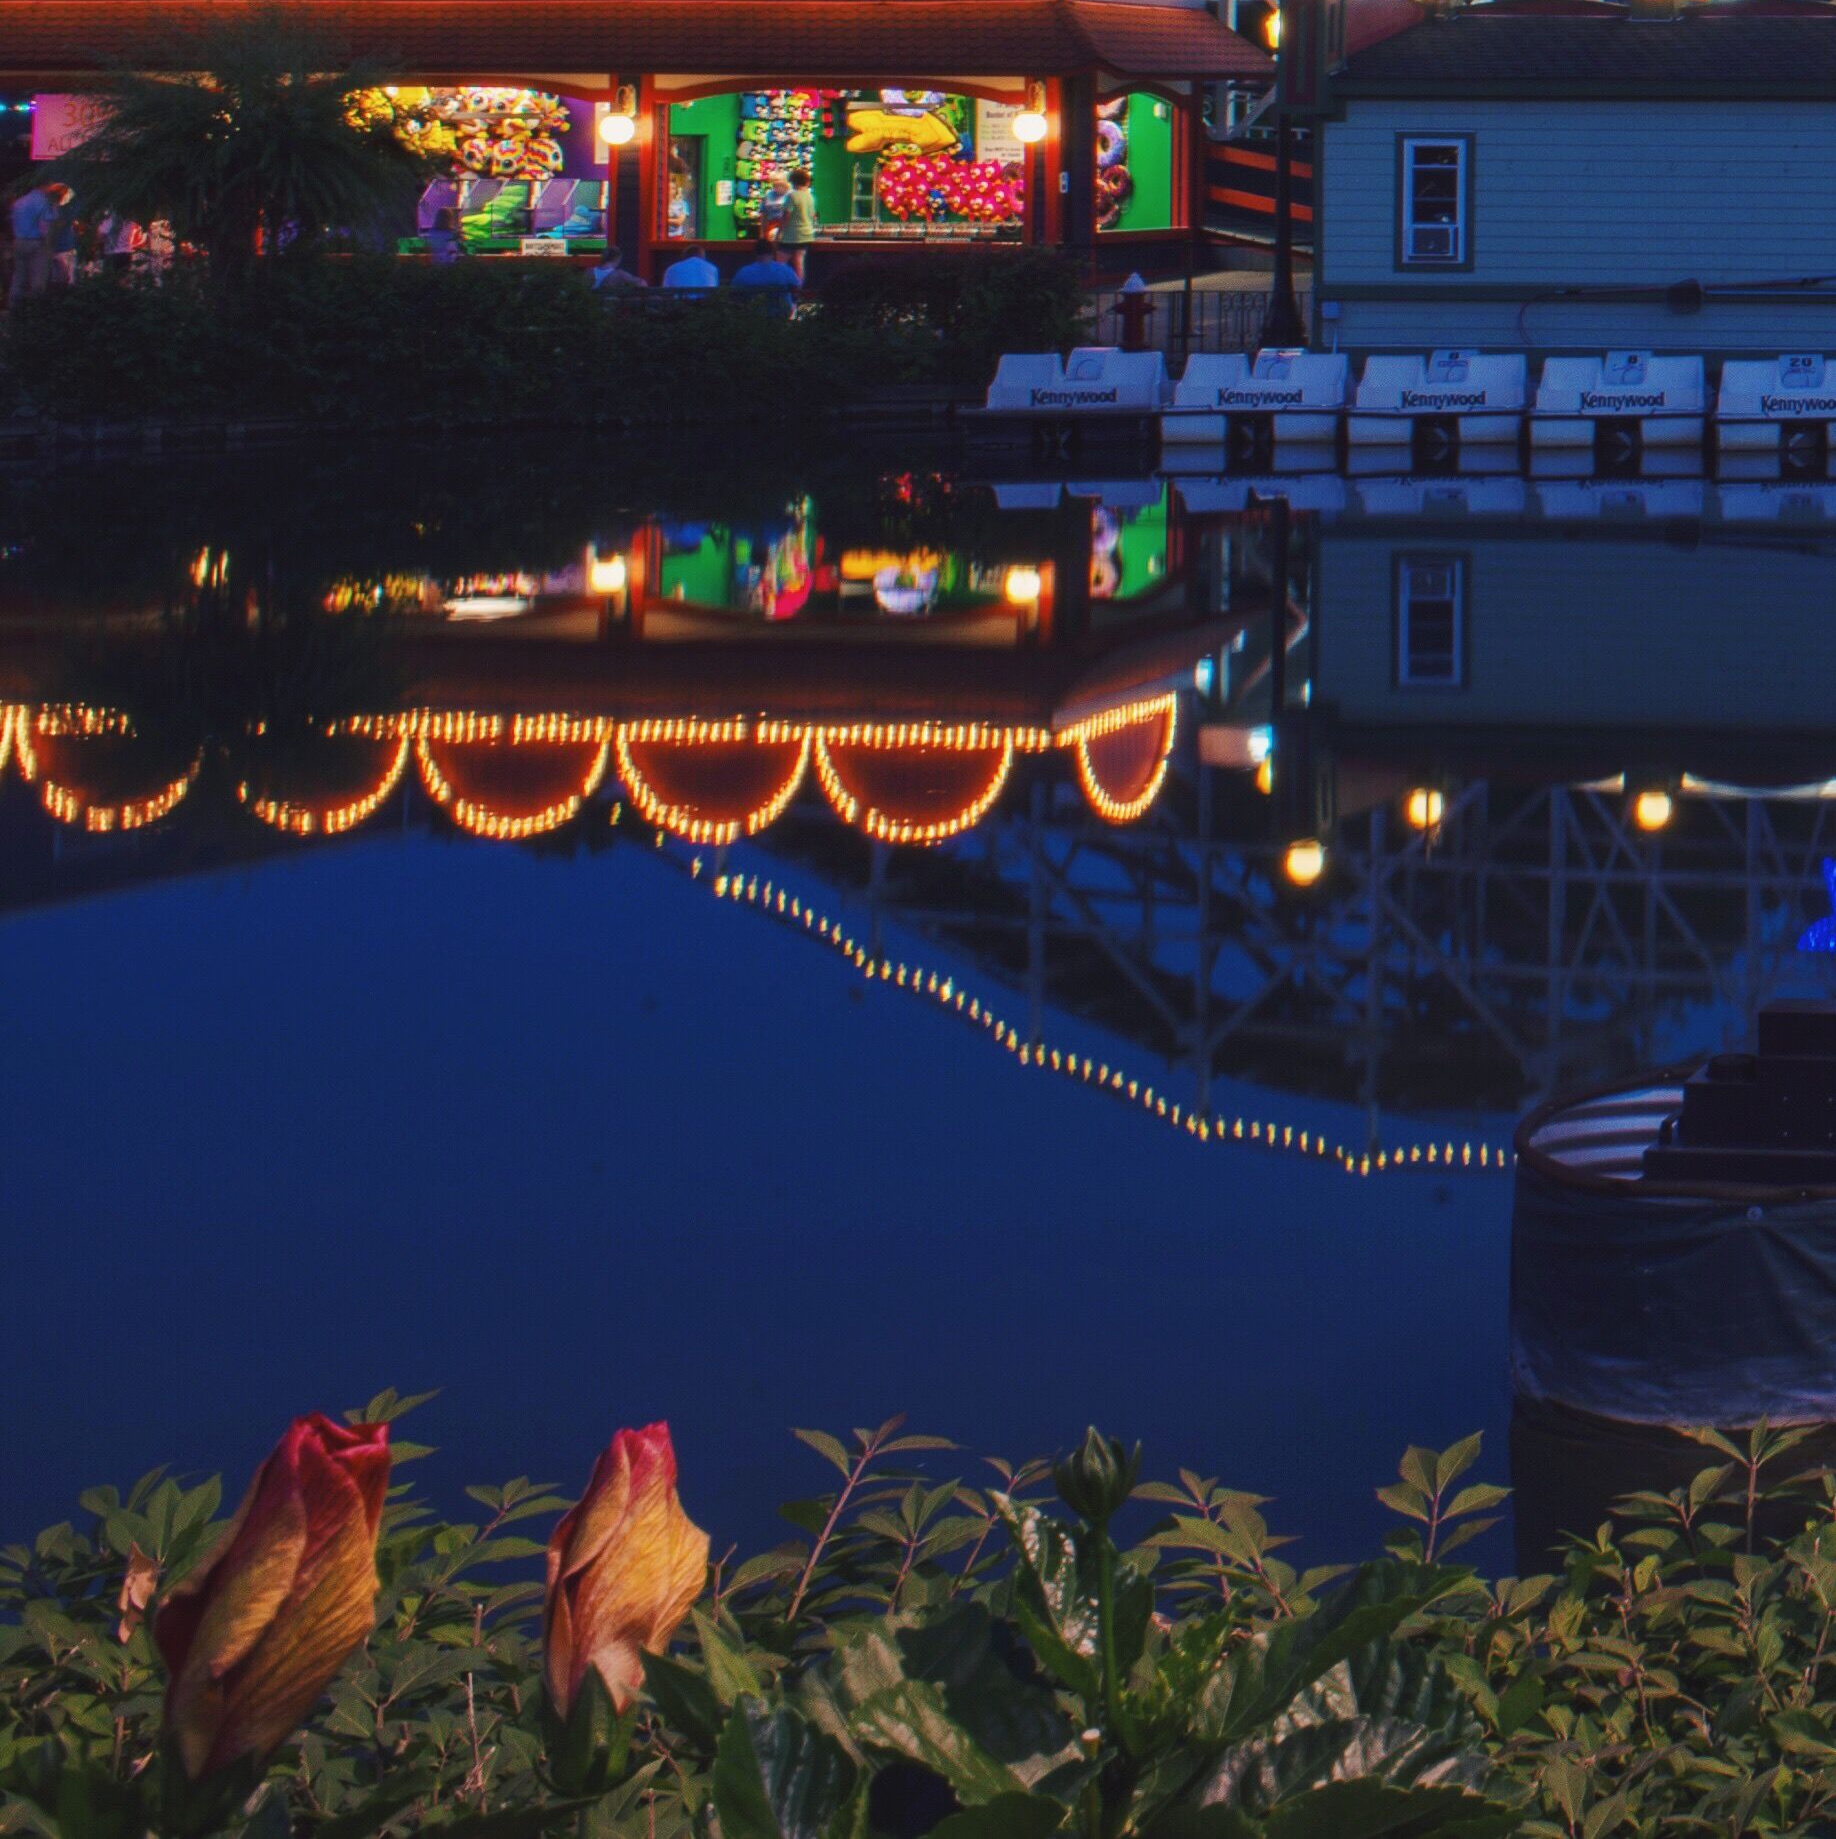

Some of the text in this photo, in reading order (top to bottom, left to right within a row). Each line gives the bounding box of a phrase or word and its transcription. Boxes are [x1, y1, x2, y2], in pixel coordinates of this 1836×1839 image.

[1030, 388, 1117, 405] Kennywood
[1217, 388, 1303, 406] Kennywood
[1401, 390, 1486, 409] Kennywood
[1580, 392, 1665, 409] Kennywood
